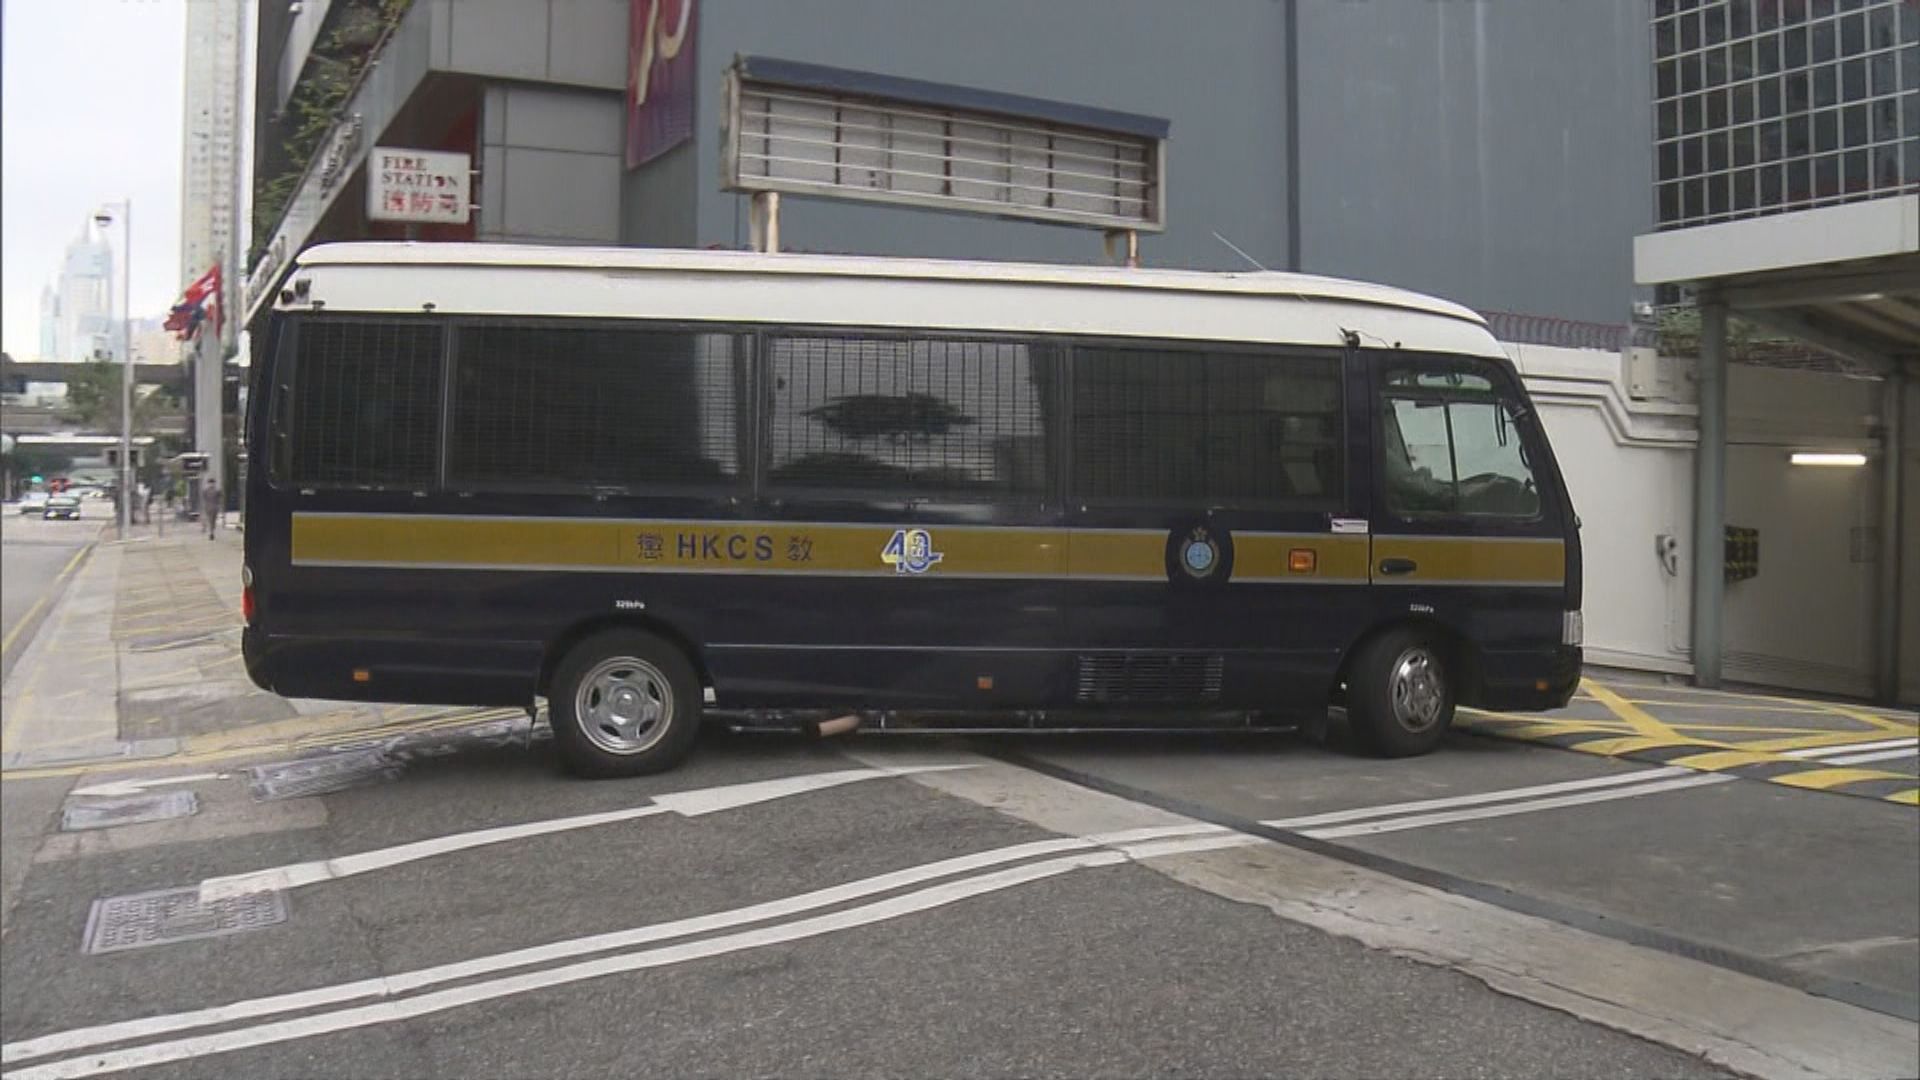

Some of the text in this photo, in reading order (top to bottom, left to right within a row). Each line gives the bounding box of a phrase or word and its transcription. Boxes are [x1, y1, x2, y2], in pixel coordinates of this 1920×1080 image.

[383, 155, 427, 171] FIRE
[382, 172, 458, 188] STATION
[677, 533, 773, 561] HKCS
[787, 536, 814, 561] 教
